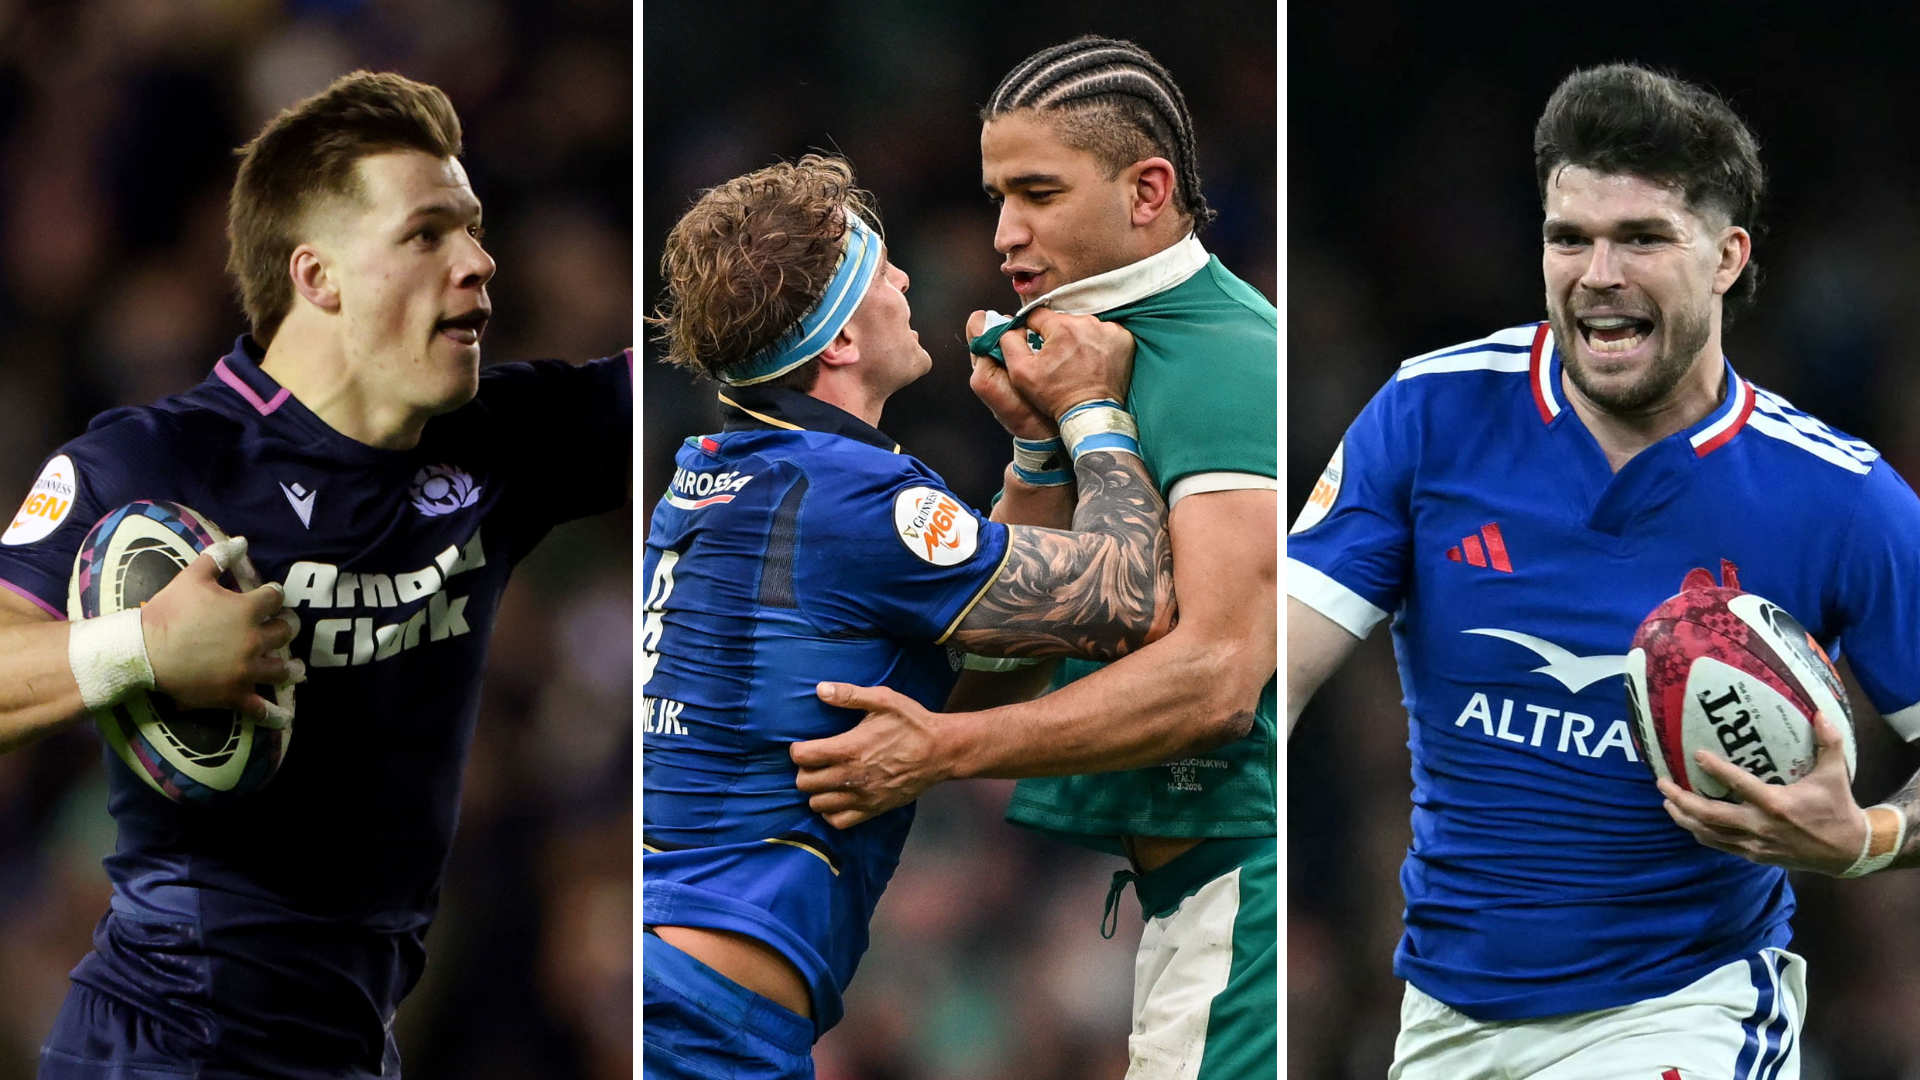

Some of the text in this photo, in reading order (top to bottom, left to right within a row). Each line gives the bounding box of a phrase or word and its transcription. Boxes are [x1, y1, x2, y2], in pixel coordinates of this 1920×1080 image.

[913, 490, 938, 529] GUINNESS
[309, 589, 471, 668] Clark
[655, 699, 689, 735] JR.
[1170, 766, 1188, 775] CAP
[1173, 775, 1196, 783] ITALY
[1167, 782, 1203, 791] 14-2-2026
